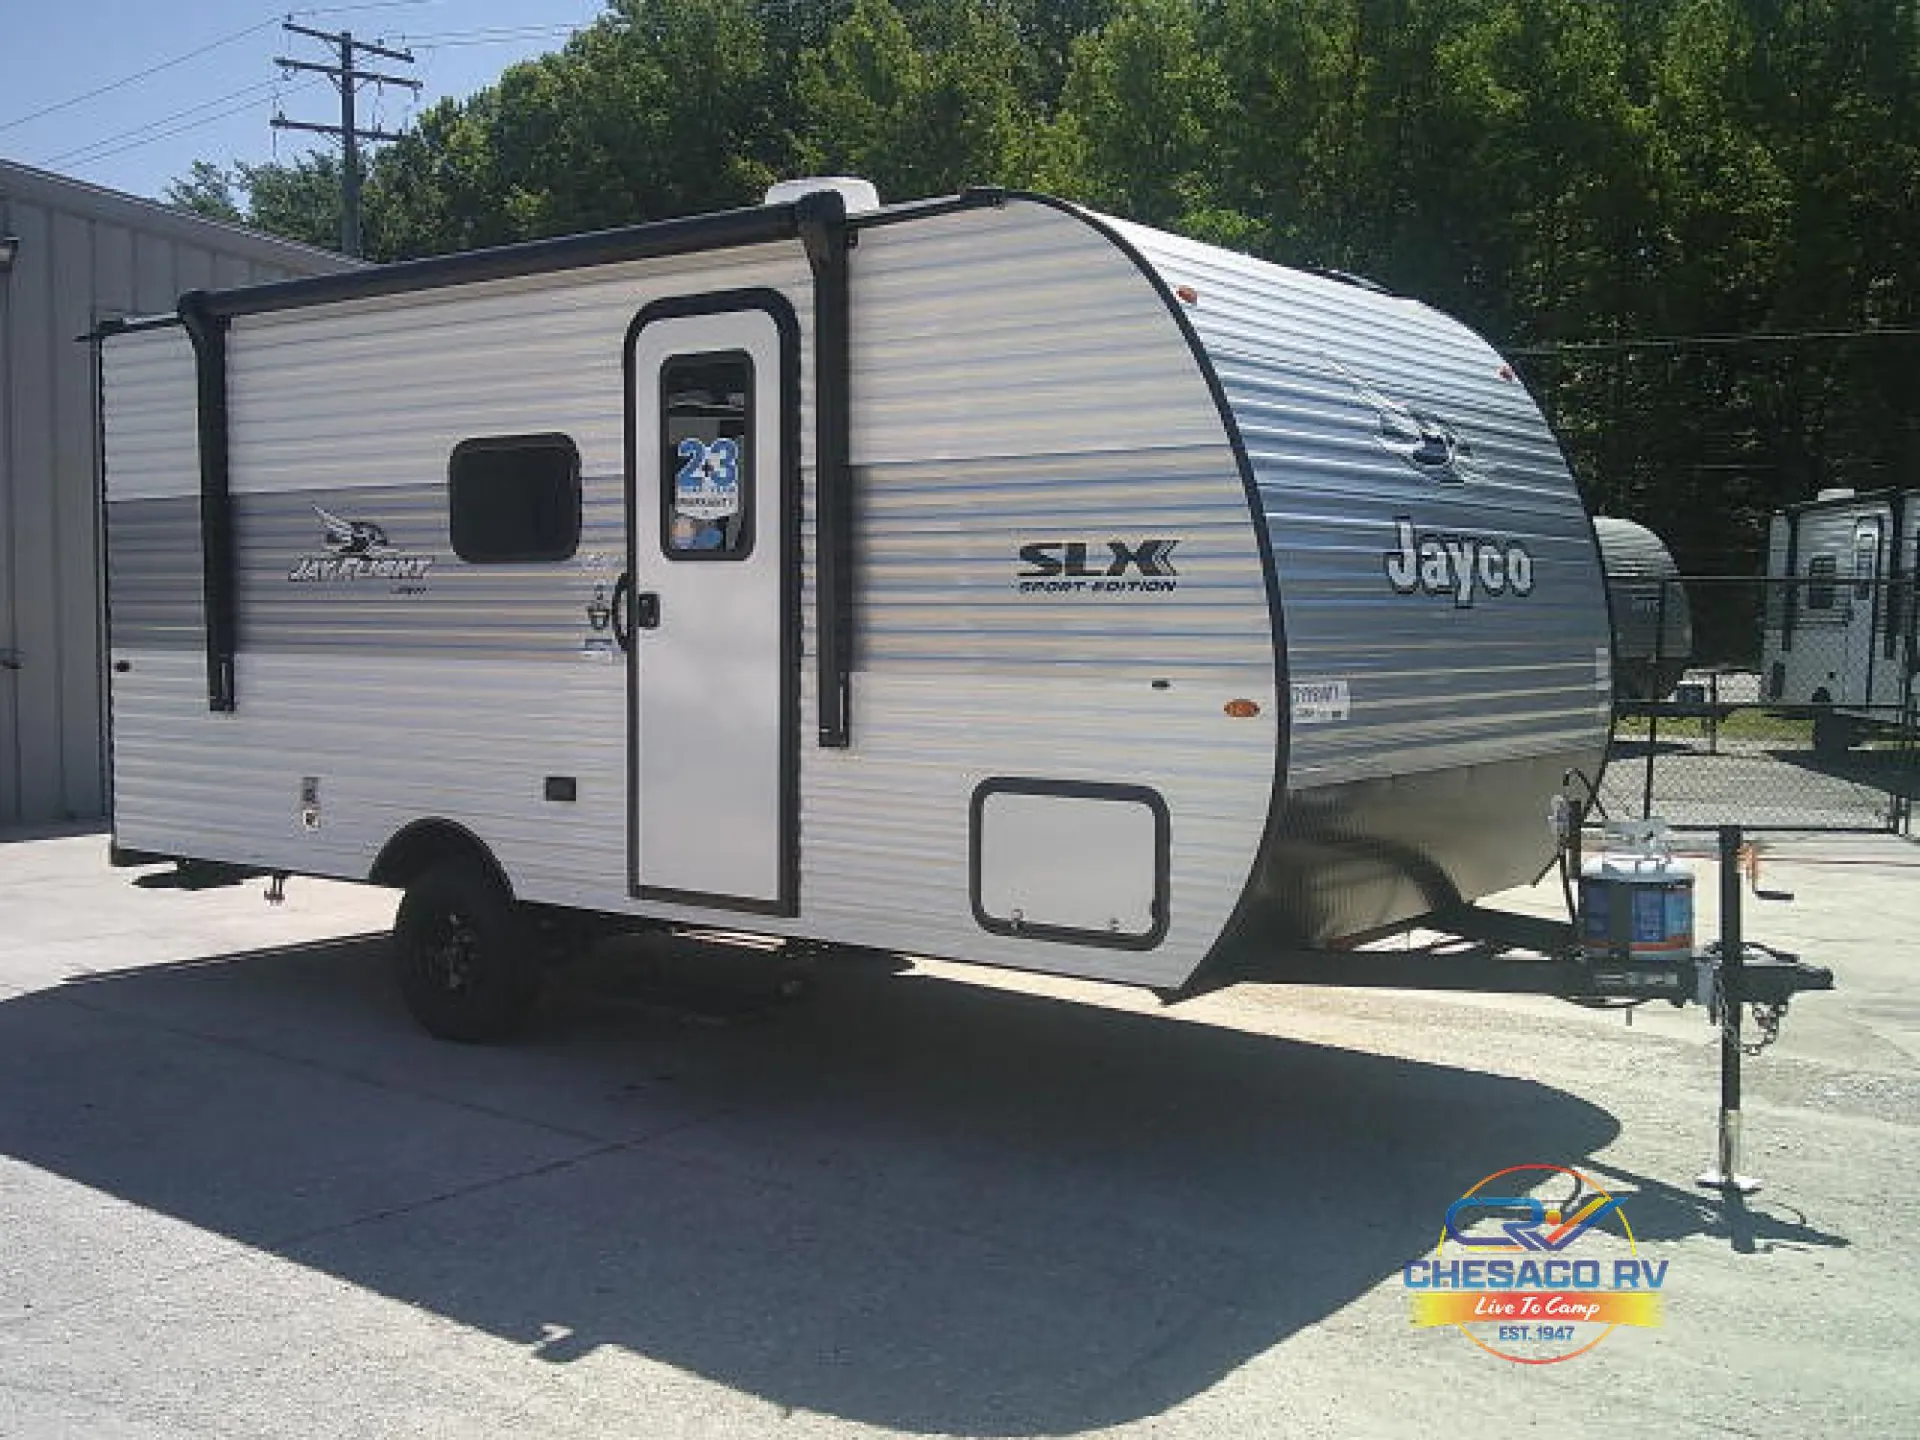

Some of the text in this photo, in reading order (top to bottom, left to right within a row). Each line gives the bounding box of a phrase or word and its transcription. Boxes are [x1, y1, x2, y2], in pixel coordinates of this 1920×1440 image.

[287, 556, 433, 581] JAY FLIGHT
[1017, 540, 1181, 577] SLX
[1386, 516, 1534, 609] Jayco
[1019, 581, 1177, 592] SPORT EDITION
